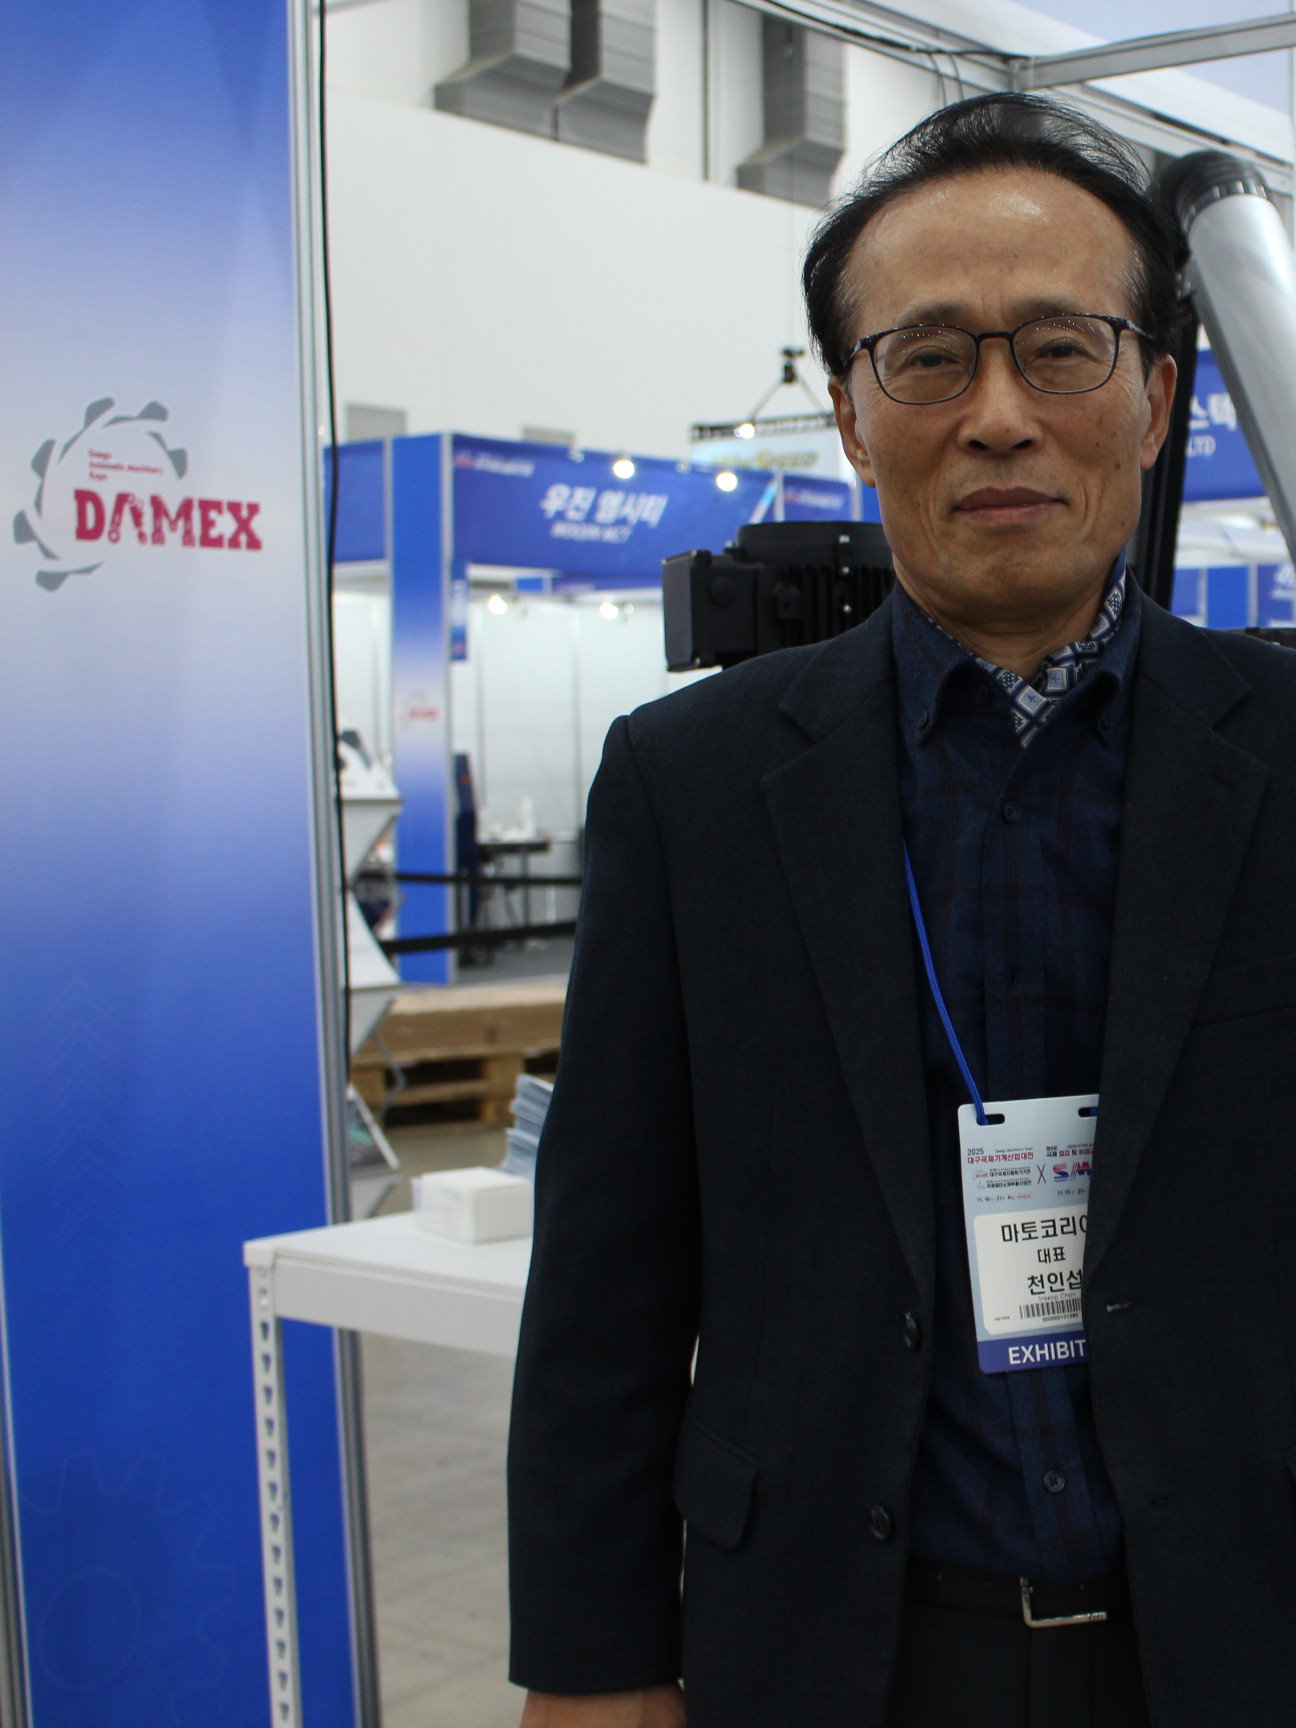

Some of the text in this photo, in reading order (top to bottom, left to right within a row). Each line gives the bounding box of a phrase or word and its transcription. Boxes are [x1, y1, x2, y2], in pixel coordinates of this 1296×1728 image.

[74, 489, 262, 550] DAMEX
[967, 1148, 984, 1157] 2025
[1037, 1246, 1066, 1264] 대표
[1027, 1269, 1084, 1295] 천인섭
[1008, 1339, 1086, 1365] EXHIBIT
